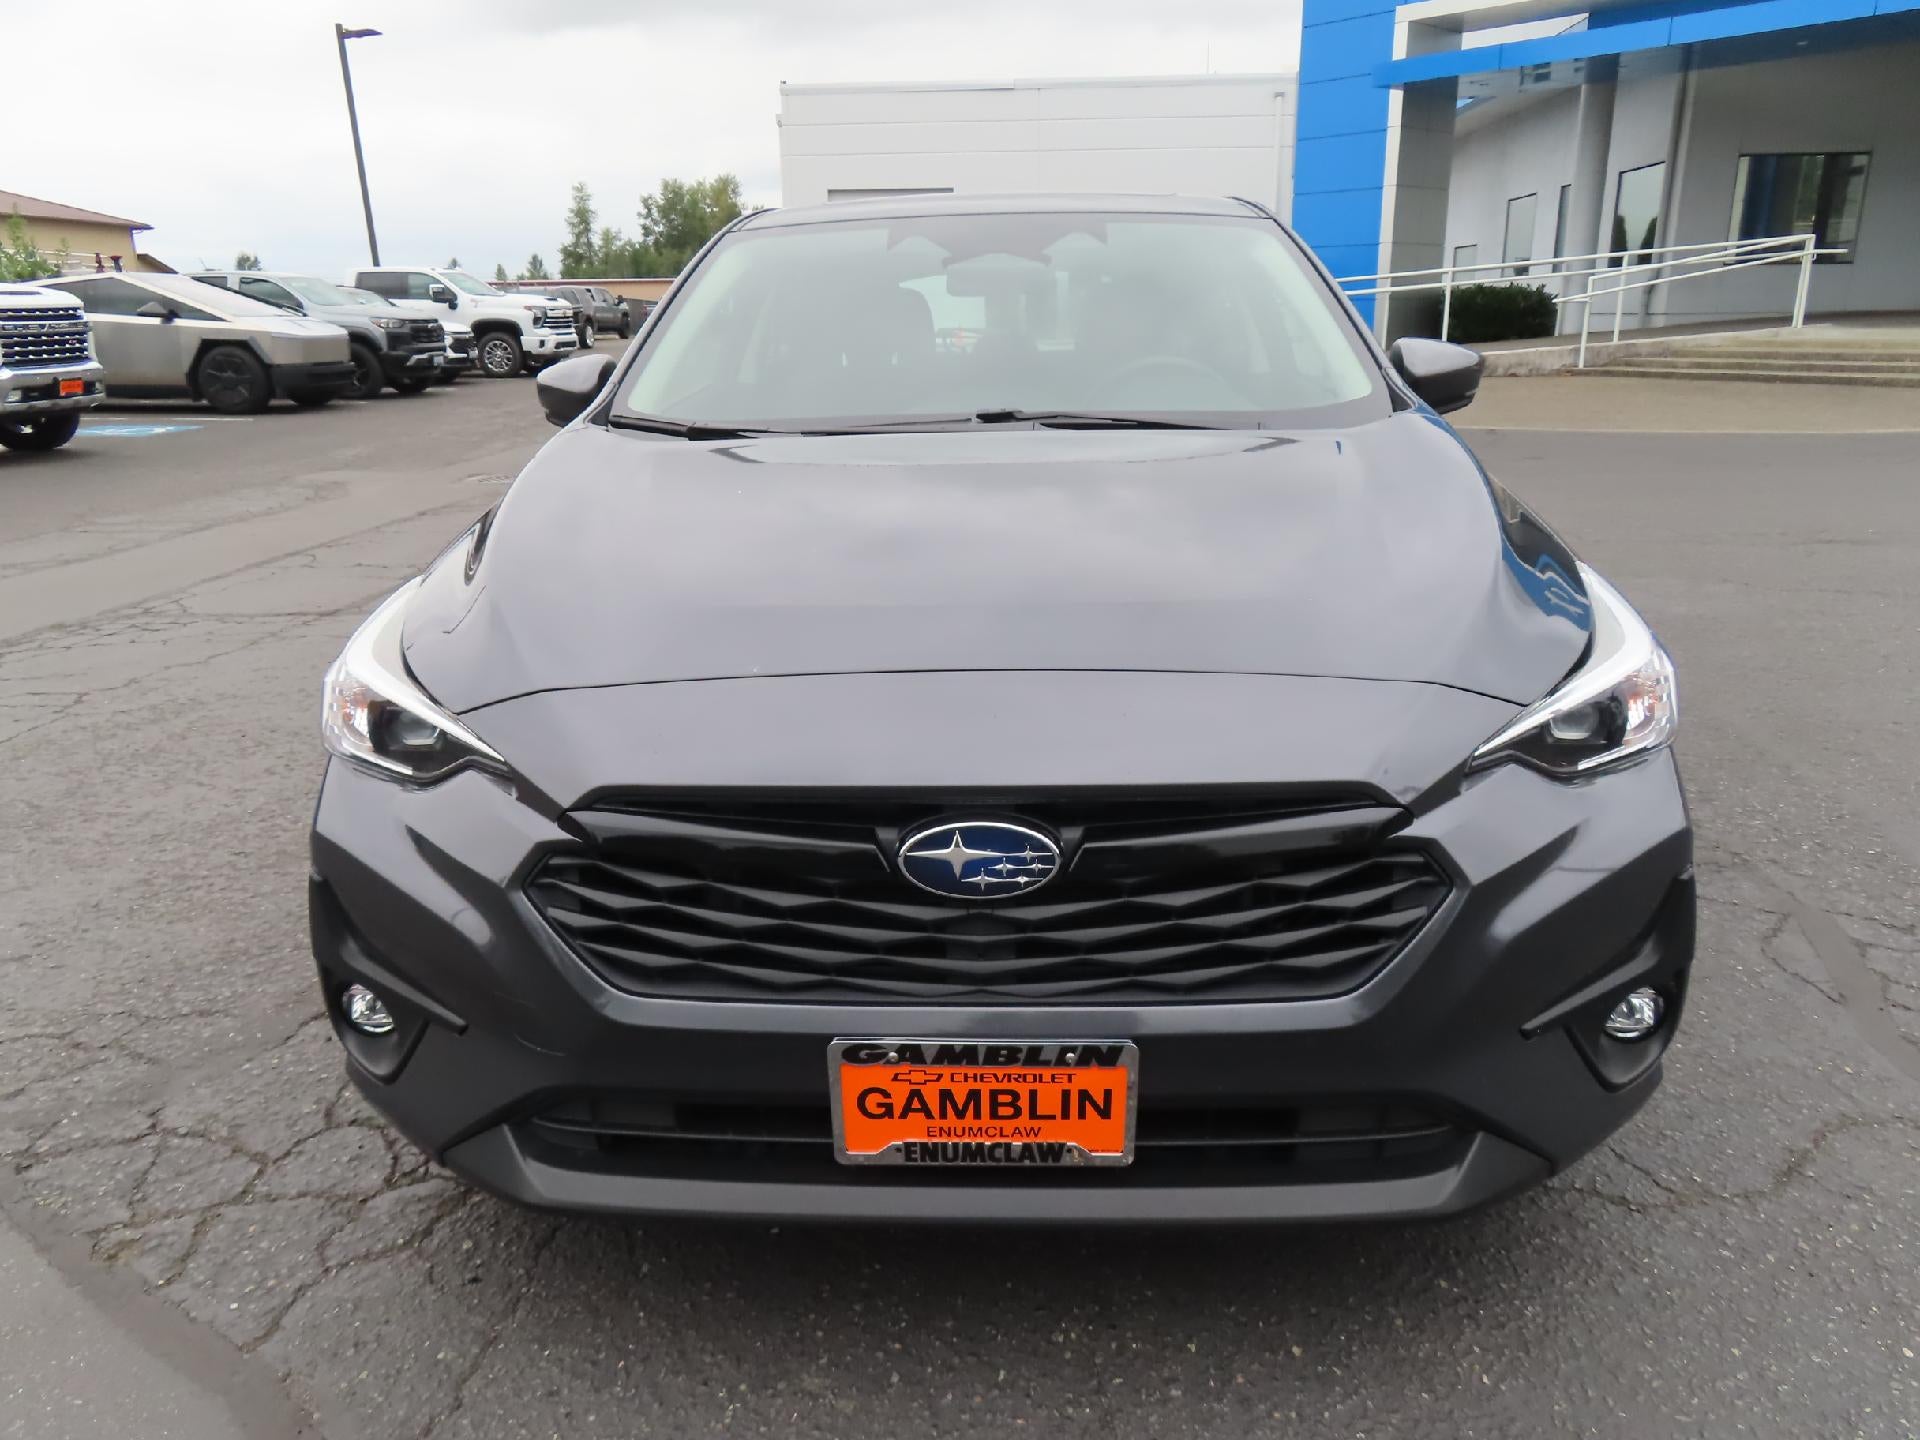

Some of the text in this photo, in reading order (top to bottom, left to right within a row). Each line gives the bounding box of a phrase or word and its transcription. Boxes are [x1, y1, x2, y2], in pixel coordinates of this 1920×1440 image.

[842, 1043, 1123, 1066] GAMBLIN
[950, 1072, 1076, 1084] CHEVROLET
[856, 1087, 1113, 1120] GAMBLIN
[927, 1126, 1042, 1138] ENUMCLAW
[903, 1142, 1067, 1163] ENUMCLAW
